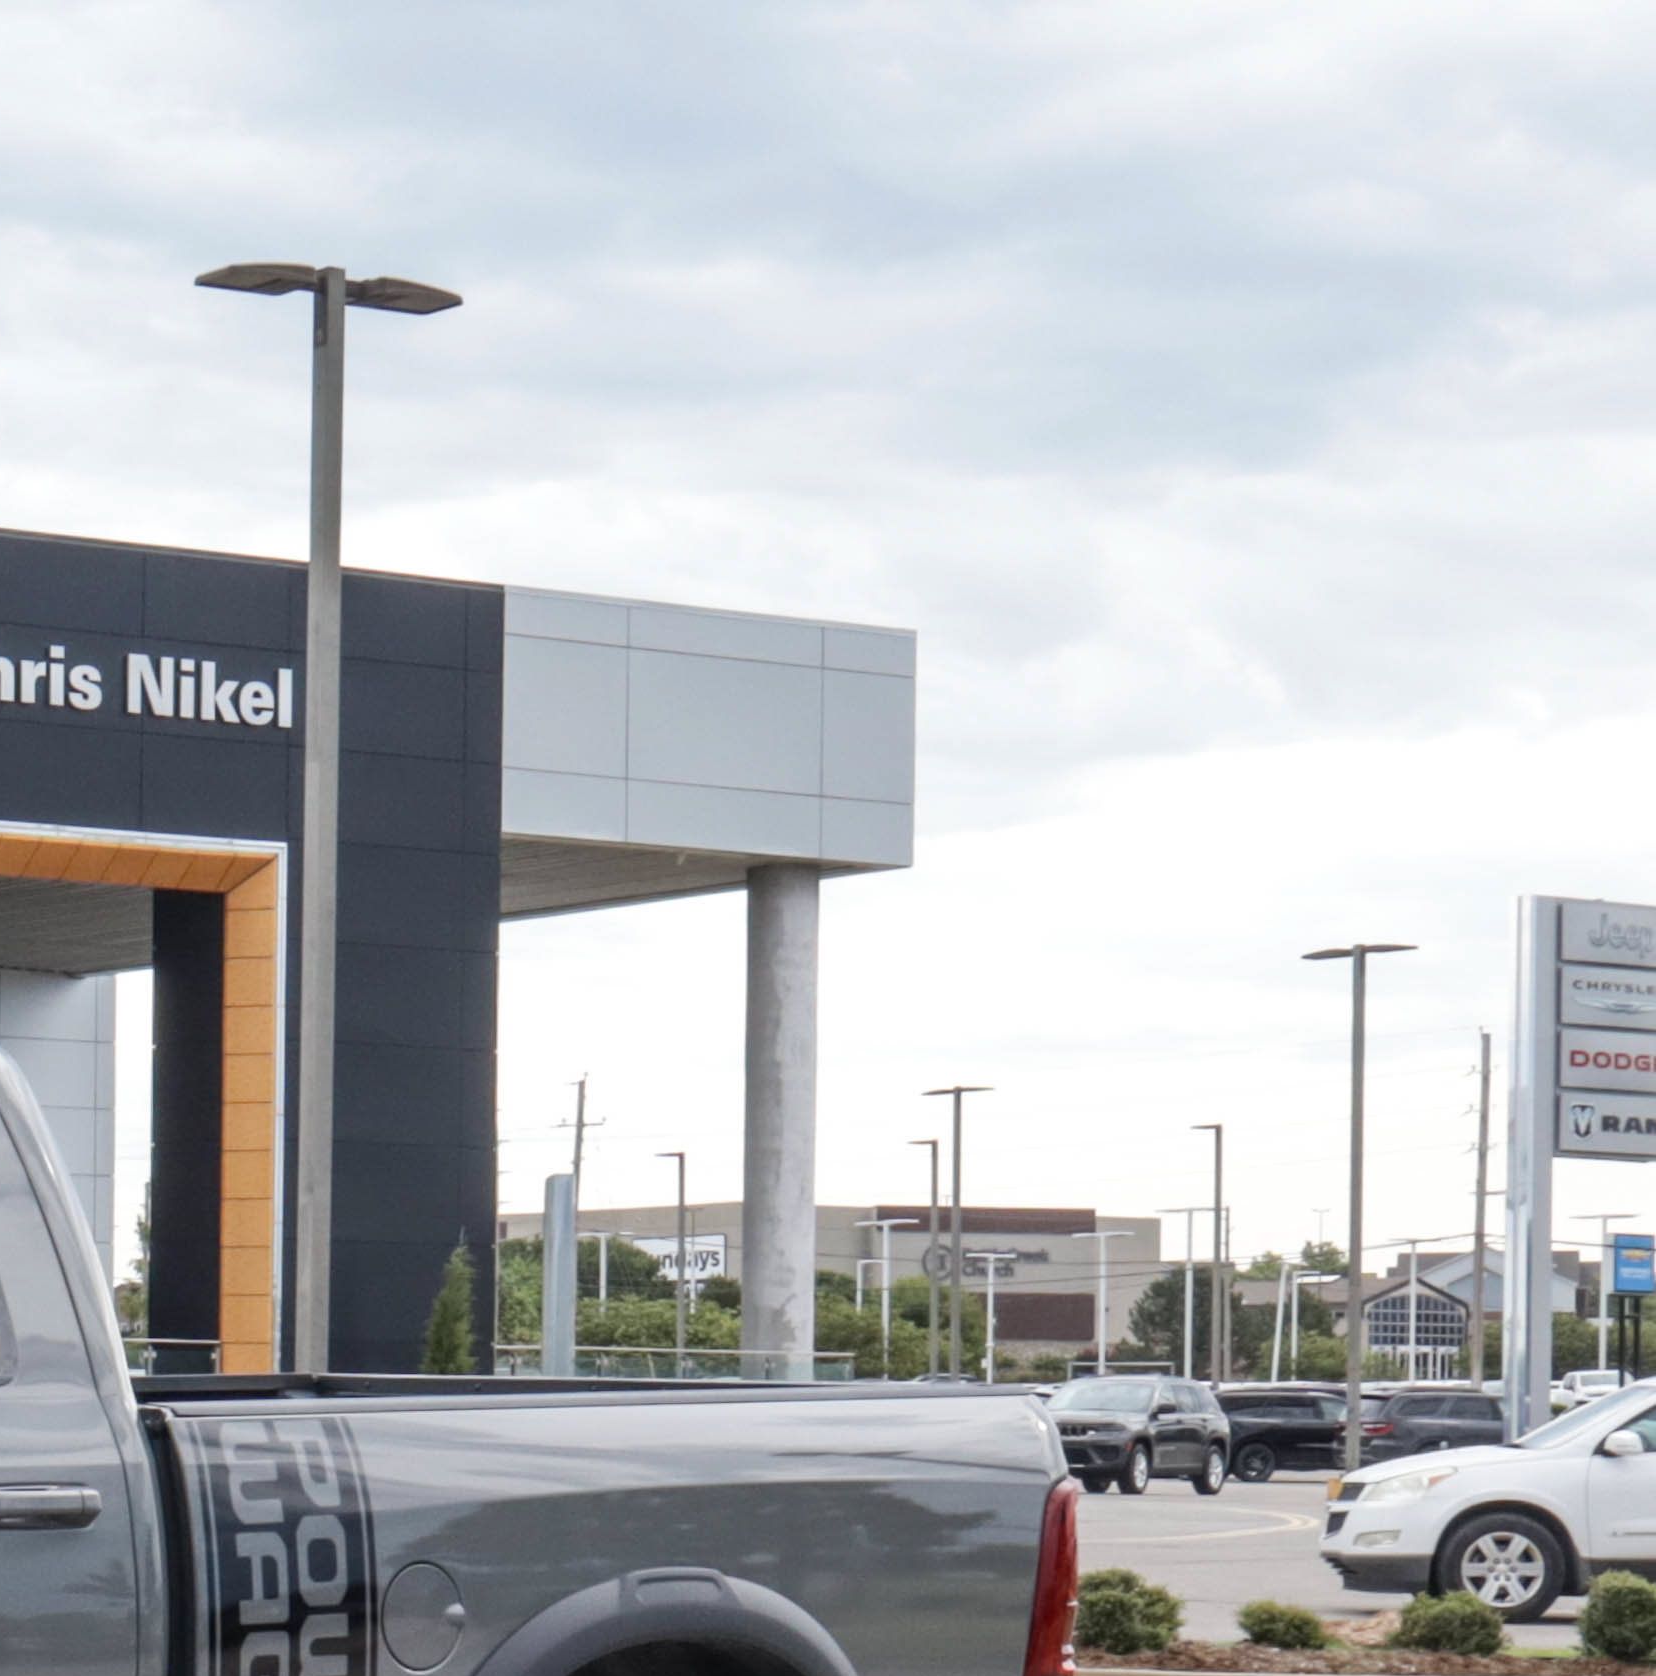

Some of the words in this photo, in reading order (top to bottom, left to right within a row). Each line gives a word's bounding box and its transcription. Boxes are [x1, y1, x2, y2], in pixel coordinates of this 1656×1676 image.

[126, 653, 293, 728] Nikel
[1587, 911, 1655, 960] Jeep
[1572, 979, 1656, 995] CHRYSLE
[1569, 1049, 1656, 1073] DODG
